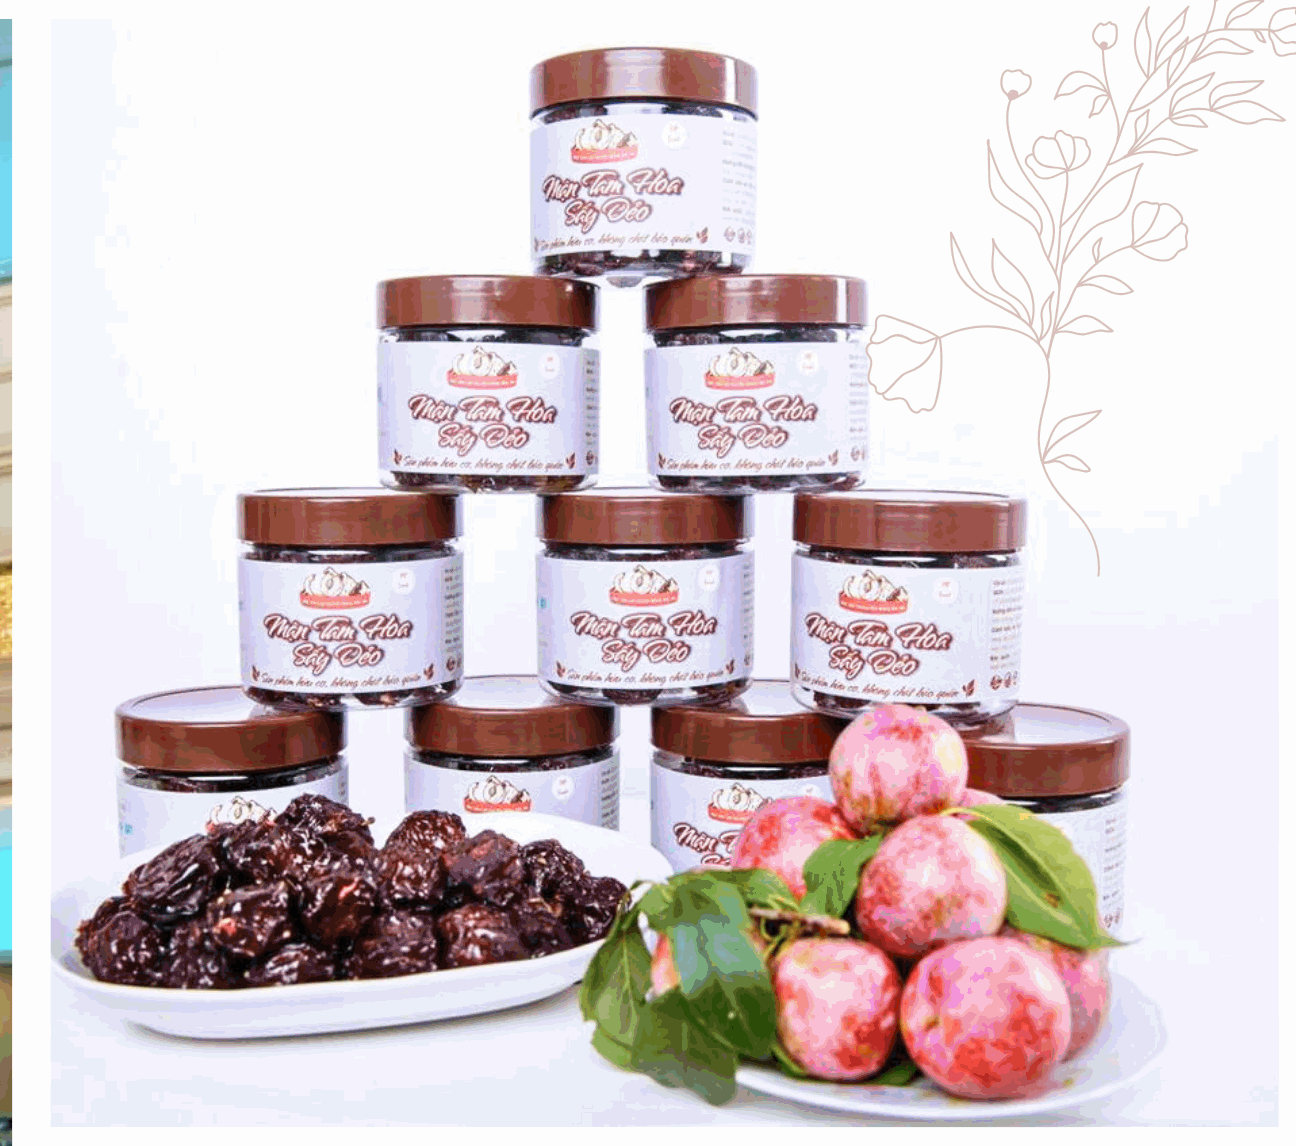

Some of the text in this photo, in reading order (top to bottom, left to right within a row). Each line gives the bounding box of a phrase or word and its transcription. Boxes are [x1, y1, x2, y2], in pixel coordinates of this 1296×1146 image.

[543, 168, 684, 202] Mận Tam Hoa
[565, 200, 599, 234] Sấy
[409, 394, 557, 424] Mận Tam Hoa
[670, 394, 818, 425] Mận Tam Hoa
[438, 422, 478, 456] Sấy
[698, 423, 736, 459] Sấy
[264, 614, 413, 643] Mận Tam Hoa
[571, 610, 717, 640] Mận Tam Hoa
[805, 612, 953, 650] Mận Tam Hoa
[293, 642, 332, 675] Sấy
[602, 639, 642, 673] Sấy
[829, 644, 864, 680] Sấy
